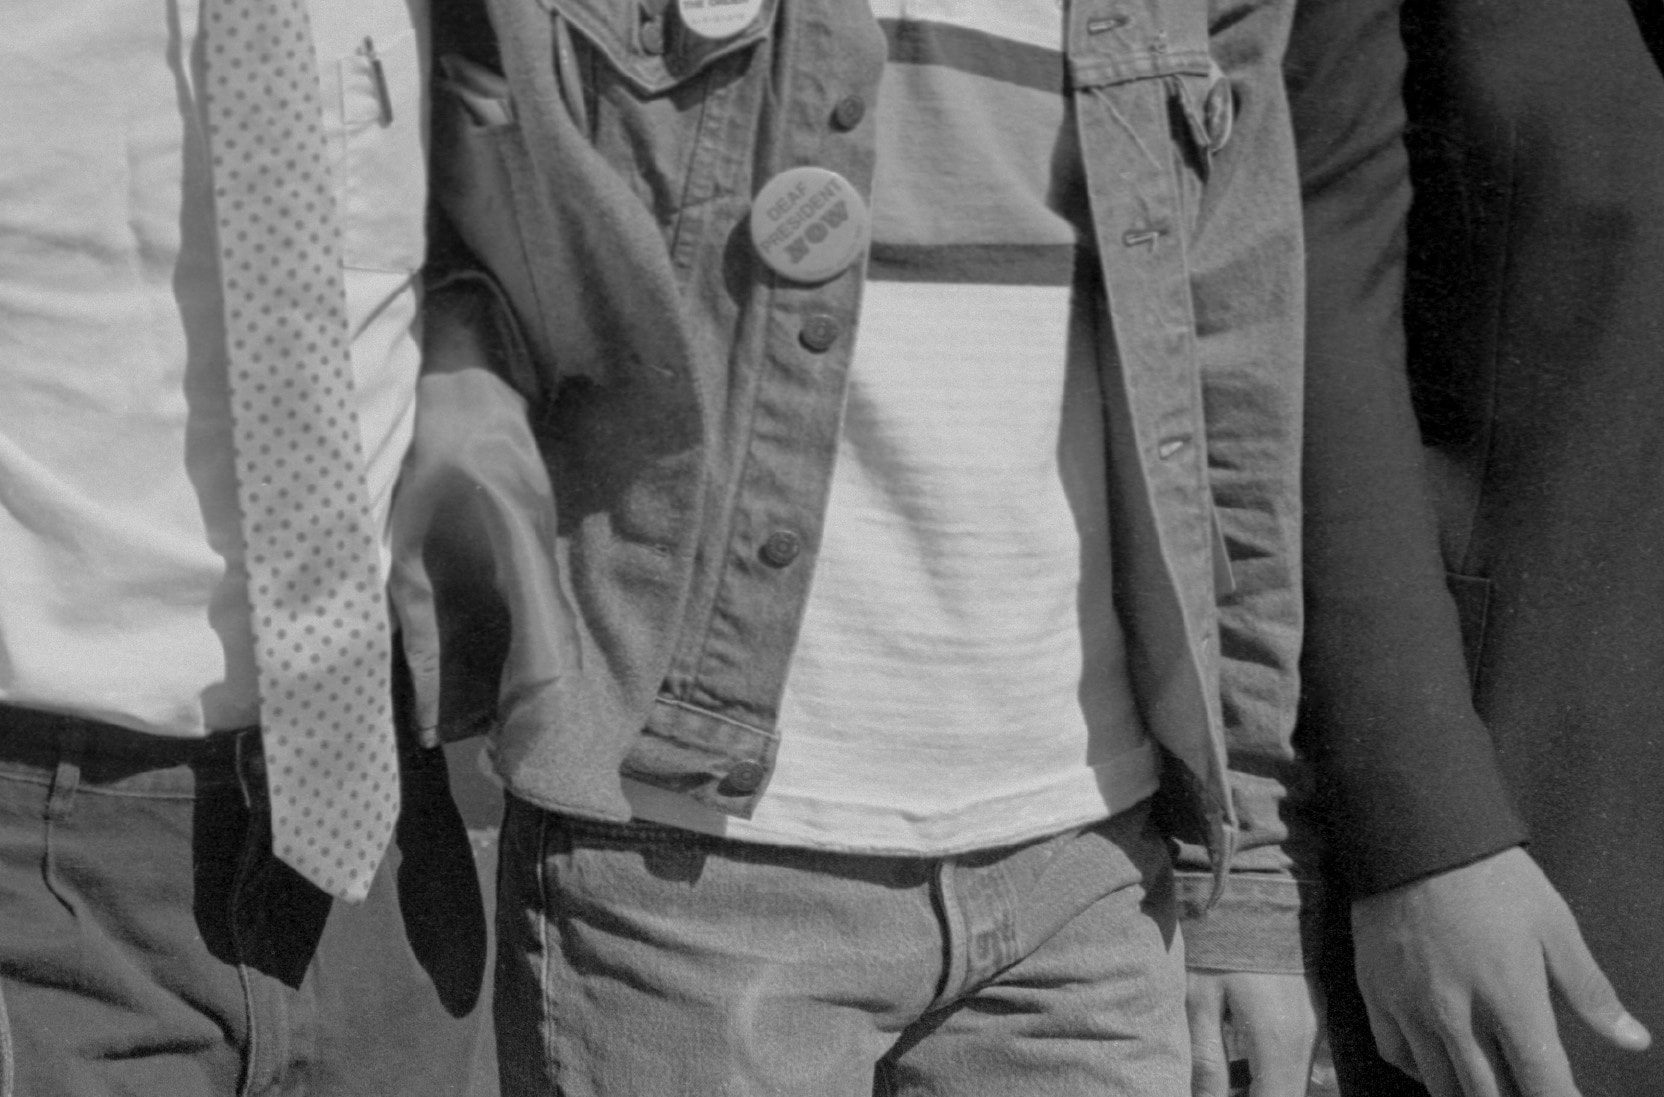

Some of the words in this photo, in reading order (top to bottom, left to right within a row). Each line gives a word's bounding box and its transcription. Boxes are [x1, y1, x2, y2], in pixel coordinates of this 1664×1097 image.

[760, 178, 841, 253] PRESIDENT
[766, 181, 806, 221] DEAF
[784, 201, 848, 264] NOW
